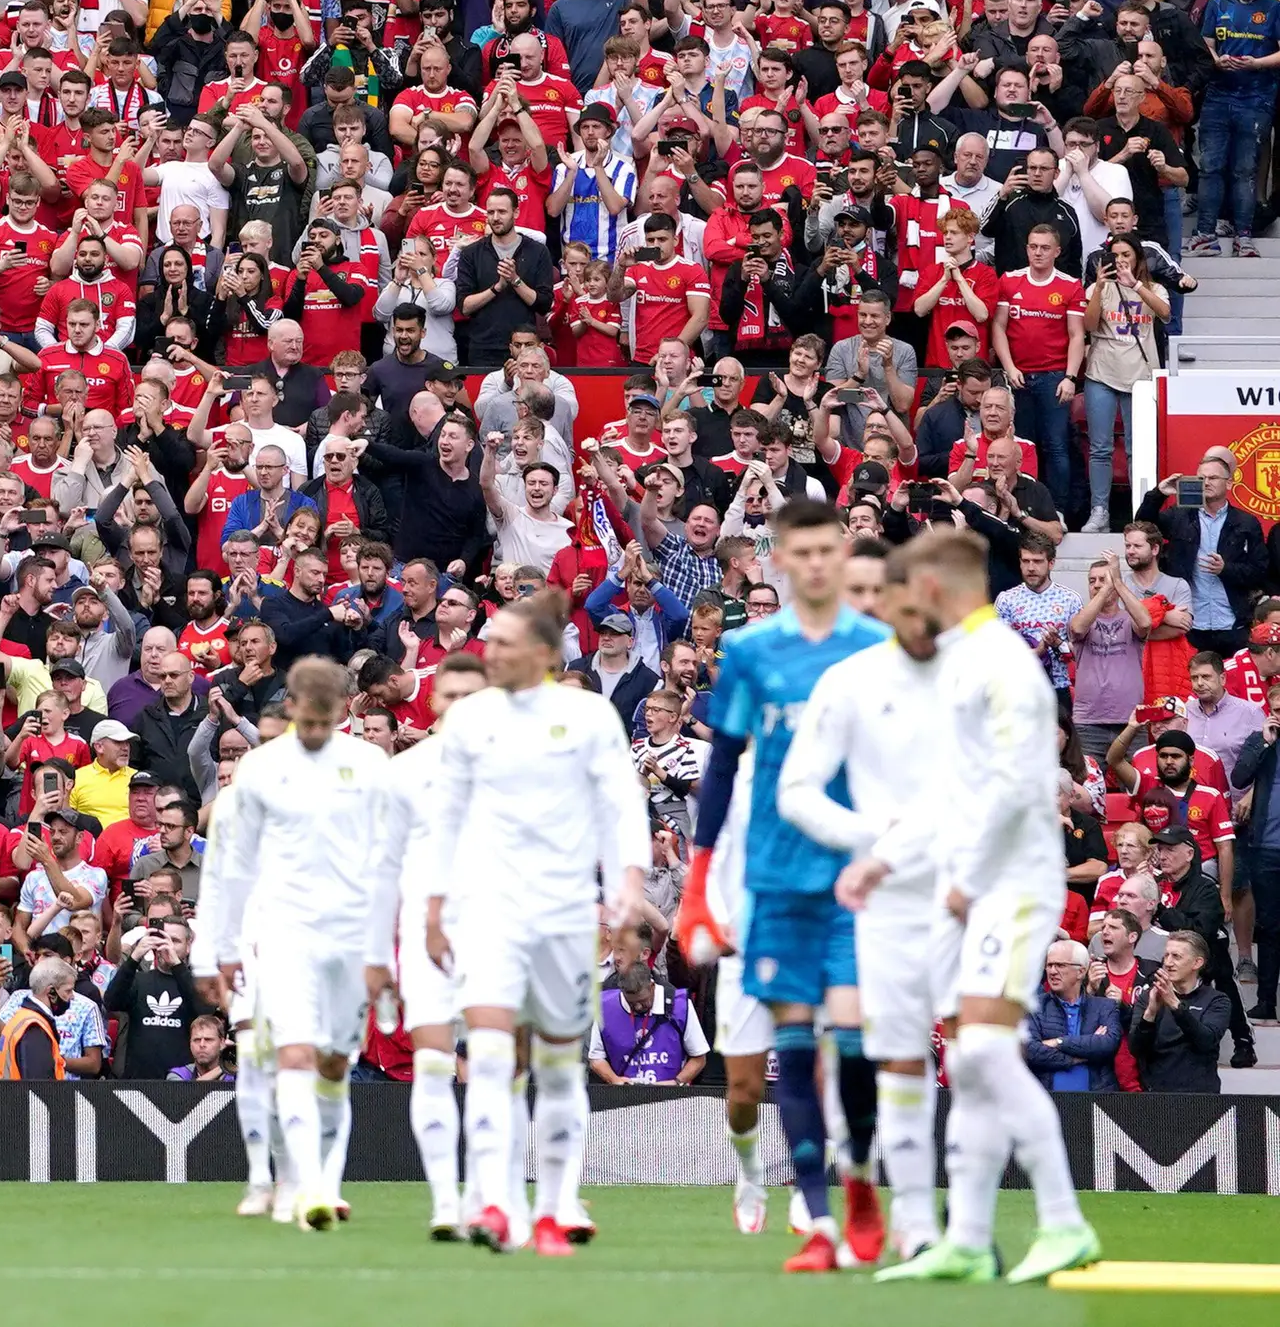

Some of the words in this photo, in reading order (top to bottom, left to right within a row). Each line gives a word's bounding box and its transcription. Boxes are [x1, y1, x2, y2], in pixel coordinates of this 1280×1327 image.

[1226, 29, 1265, 41] TeamViewer
[644, 293, 682, 303] TeamViewer
[303, 303, 342, 311] CHEVROLET
[1020, 309, 1062, 321] TeamViewer
[1236, 386, 1280, 406] W1
[142, 1015, 182, 1028] adidas
